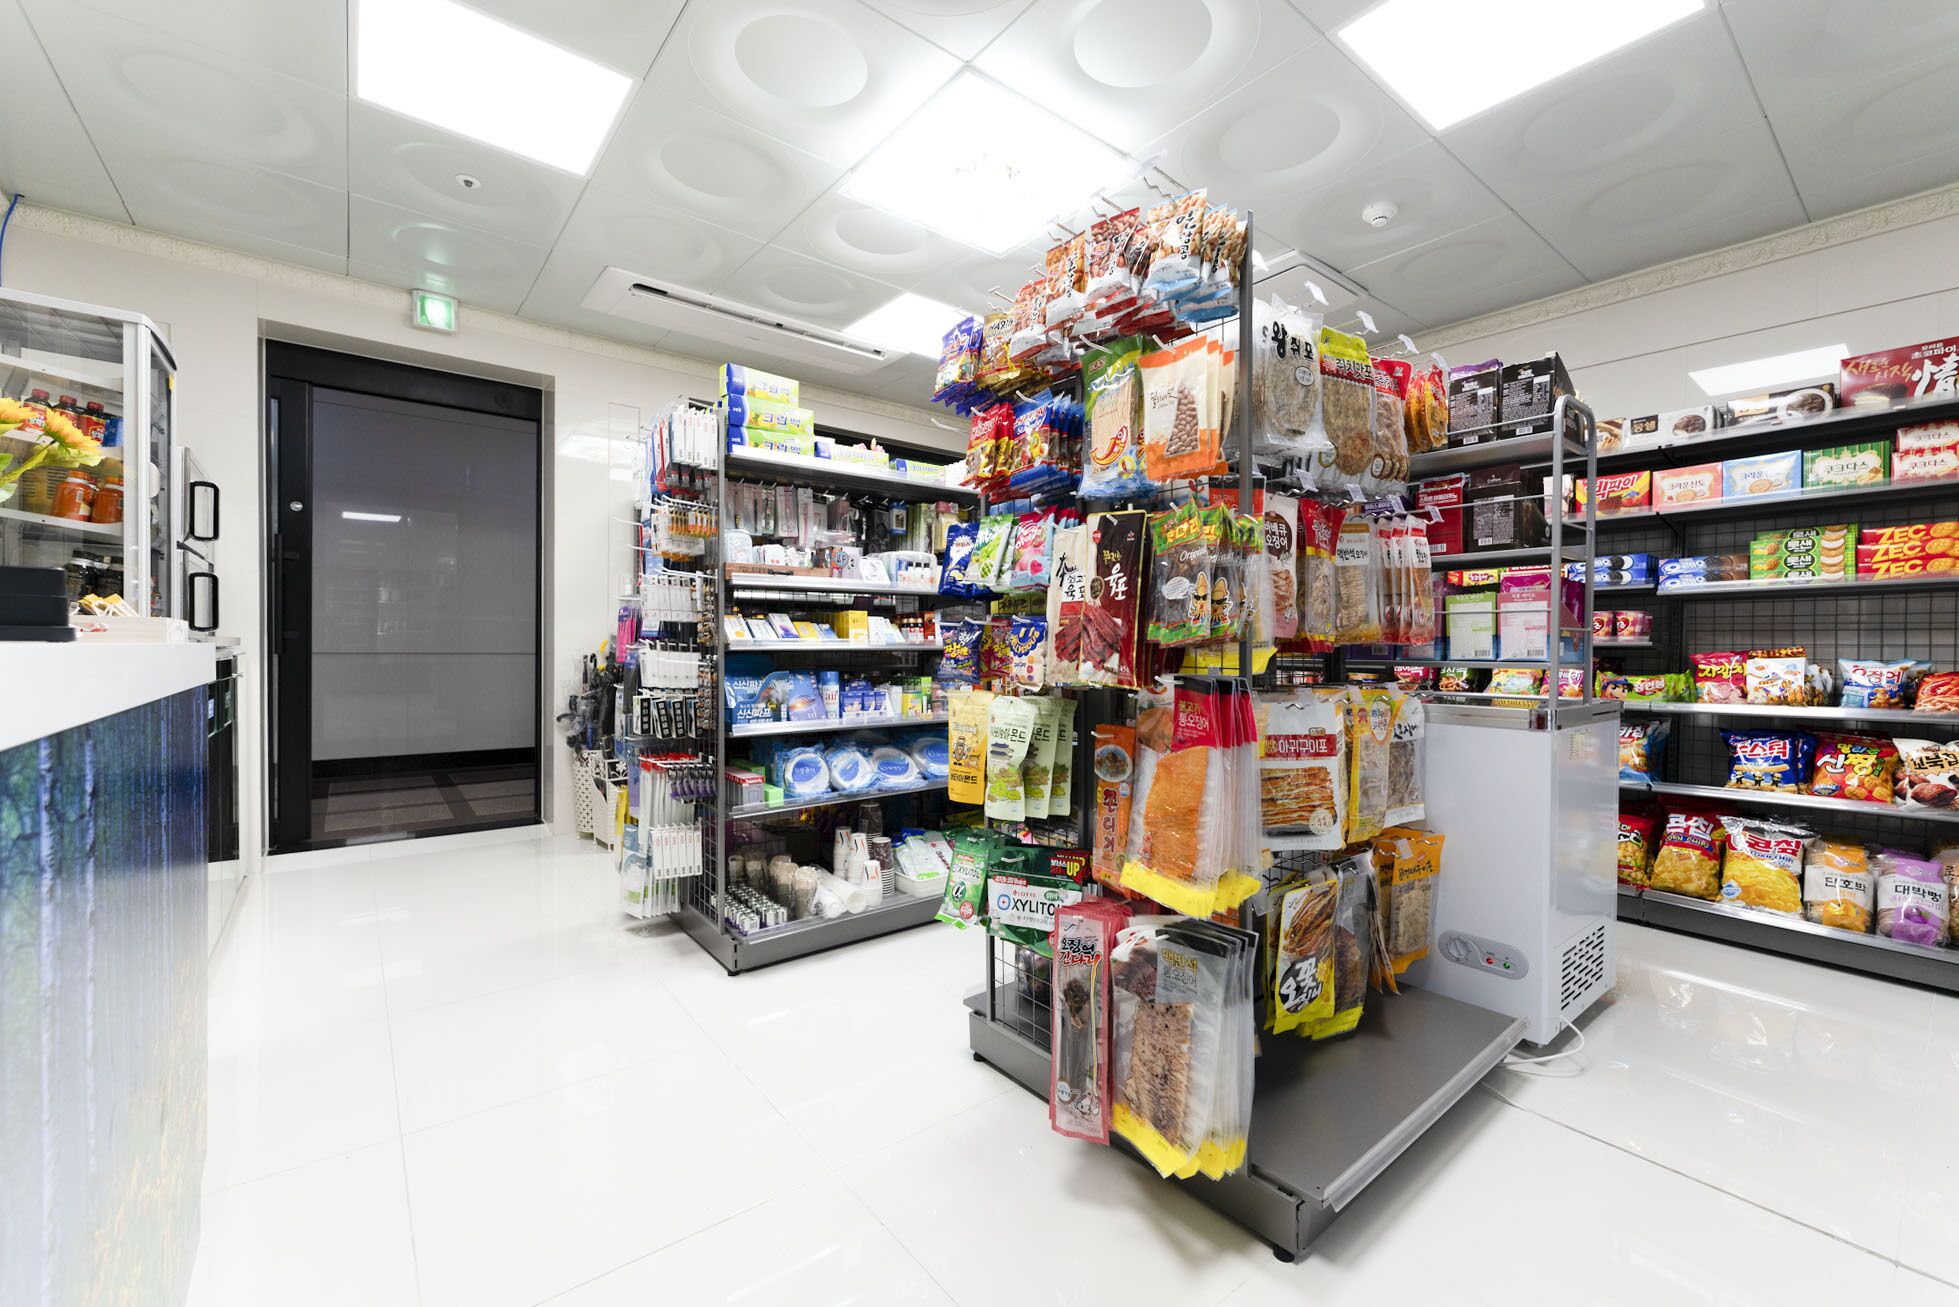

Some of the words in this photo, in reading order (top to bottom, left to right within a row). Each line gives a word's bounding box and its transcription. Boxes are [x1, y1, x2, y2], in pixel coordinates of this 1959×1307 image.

[1916, 430, 1951, 442] 쿠크다스
[1823, 461, 1869, 475] 쿠크다스
[1908, 458, 1948, 470] 쿠크다스
[1876, 525, 1927, 544] ZEC
[1871, 540, 1922, 563] ZEC
[1871, 559, 1923, 580] ZEC
[1697, 662, 1748, 679] 자갈치
[1852, 664, 1903, 685] 오징어
[1278, 738, 1328, 753] 아귀구이포
[1816, 753, 1878, 777] 신짱
[958, 865, 981, 881] XYLITOL
[1066, 861, 1081, 877] UP
[1824, 875, 1866, 894] 단호박
[1894, 883, 1943, 903] 대박뻥
[1061, 935, 1096, 955] 오징어
